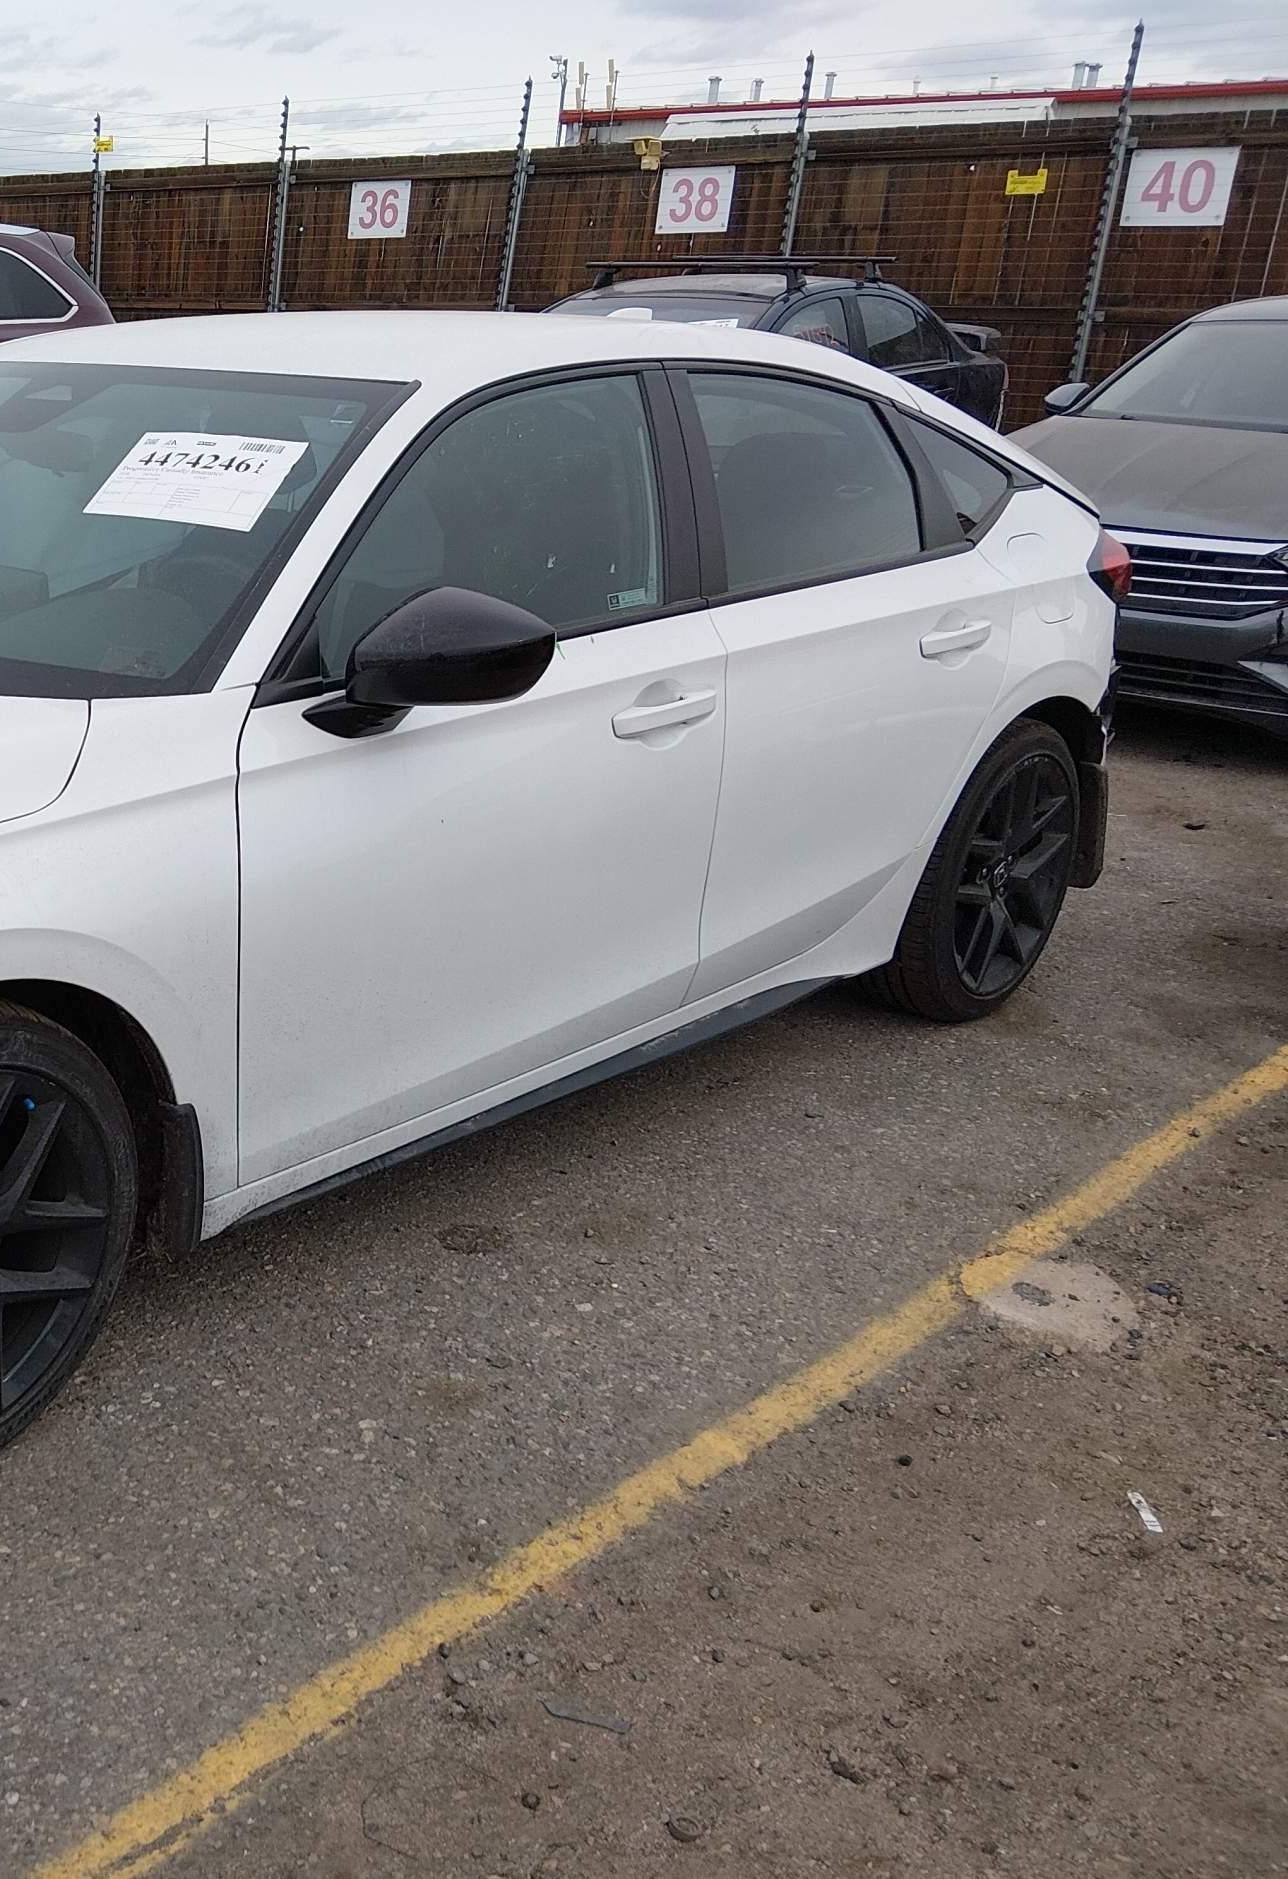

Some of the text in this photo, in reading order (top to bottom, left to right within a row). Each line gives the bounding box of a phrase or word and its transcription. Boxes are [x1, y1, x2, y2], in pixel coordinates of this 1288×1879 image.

[359, 189, 399, 229] 36
[669, 177, 720, 223] 38
[1141, 160, 1216, 213] 40
